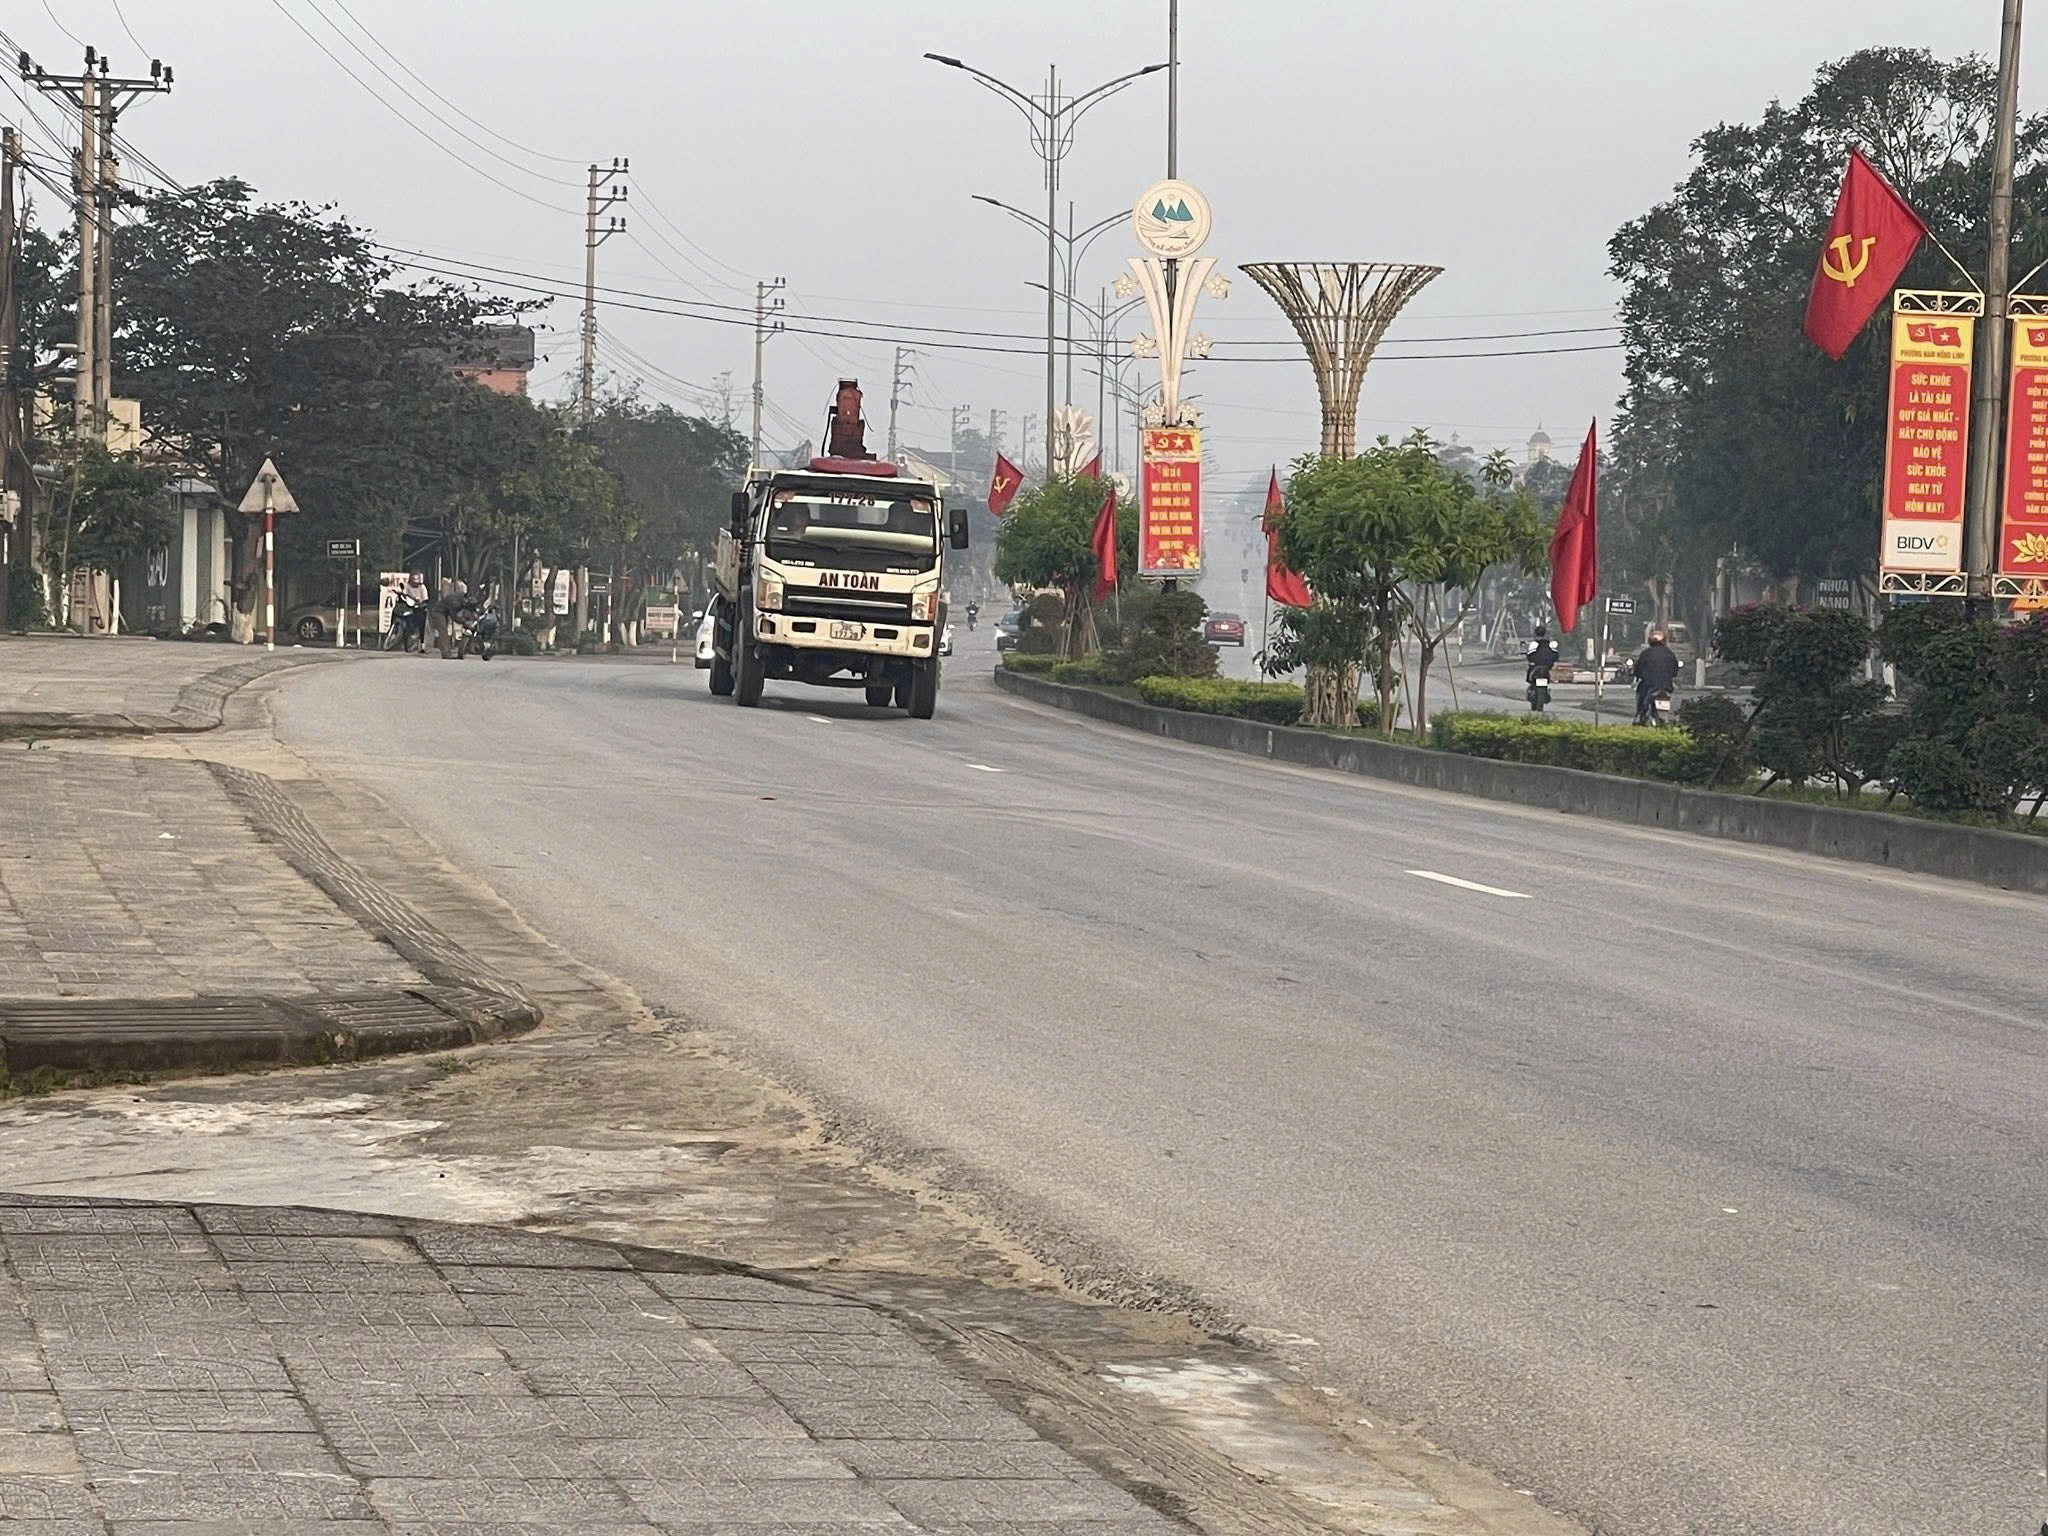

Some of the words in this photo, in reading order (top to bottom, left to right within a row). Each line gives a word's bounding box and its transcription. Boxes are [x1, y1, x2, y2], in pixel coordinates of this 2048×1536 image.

[1911, 371, 1928, 386] SỨC
[1909, 389, 1919, 403] LÀ
[1920, 390, 1934, 404] TÀI
[1935, 390, 1952, 405] SẢN
[1899, 407, 1916, 422] QUÝ
[1917, 407, 1932, 422] GIÁ
[1932, 408, 1954, 423] NHẤT
[1898, 425, 1915, 439] HÃY
[1916, 426, 1934, 440] CHỦ
[1935, 427, 1958, 443] ĐỘNG
[1913, 444, 1930, 458] BẢO
[1931, 444, 1942, 461] VỆ
[1907, 462, 1924, 477] SỨC
[1908, 482, 1930, 495] NGAY
[1931, 481, 1944, 495] TỪ
[1904, 498, 1925, 513] HÔM
[1925, 501, 1945, 514] NAY!
[1897, 536, 1935, 549] BIDV
[818, 572, 839, 587] AN
[842, 571, 880, 590] TOÀN
